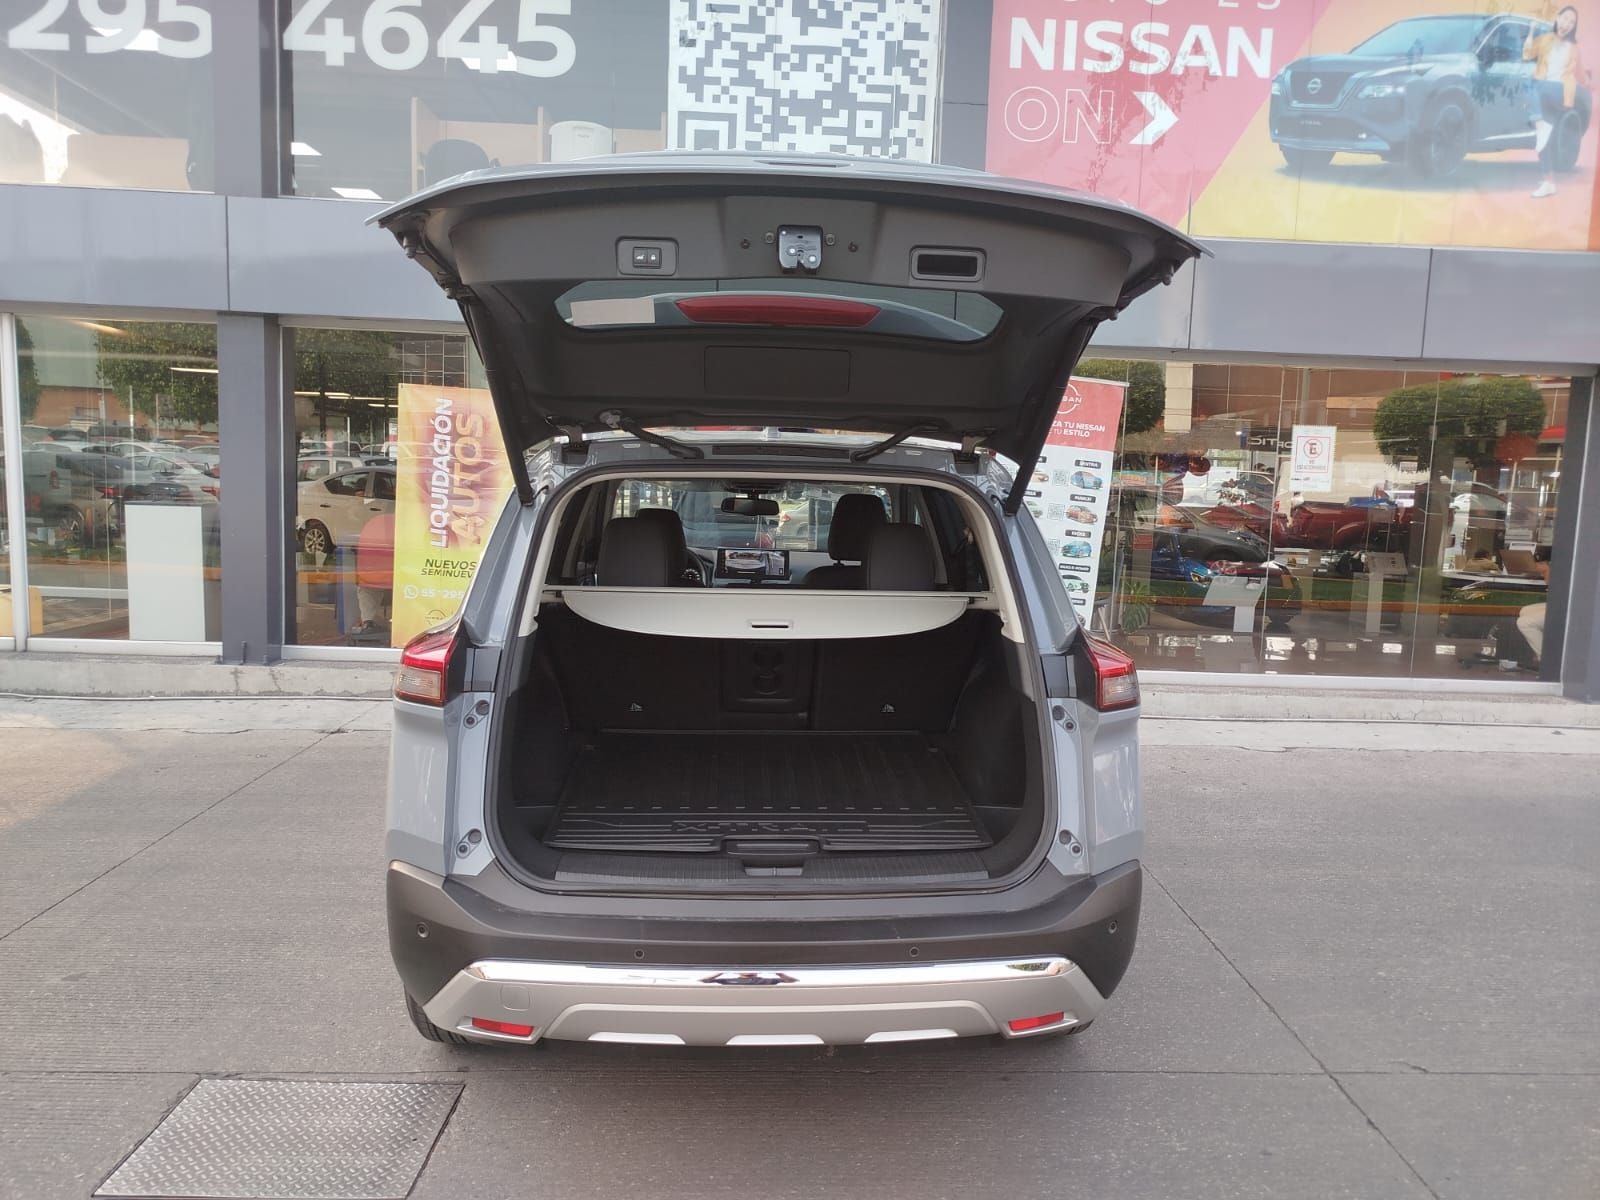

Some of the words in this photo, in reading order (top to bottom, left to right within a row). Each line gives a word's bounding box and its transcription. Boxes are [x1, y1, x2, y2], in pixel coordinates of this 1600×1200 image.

[8, 0, 213, 59] 295
[282, 0, 577, 78] 4645
[1008, 16, 1274, 79] NISSAN
[1004, 86, 1116, 144] ON
[1063, 429, 1091, 438] ESTILO
[1076, 422, 1106, 433] NISSAN
[430, 398, 453, 549] LIQUIDACIÓN
[450, 413, 486, 546] AUTOS
[421, 568, 474, 578] SEMINUEV
[424, 558, 477, 571] NUEVOS
